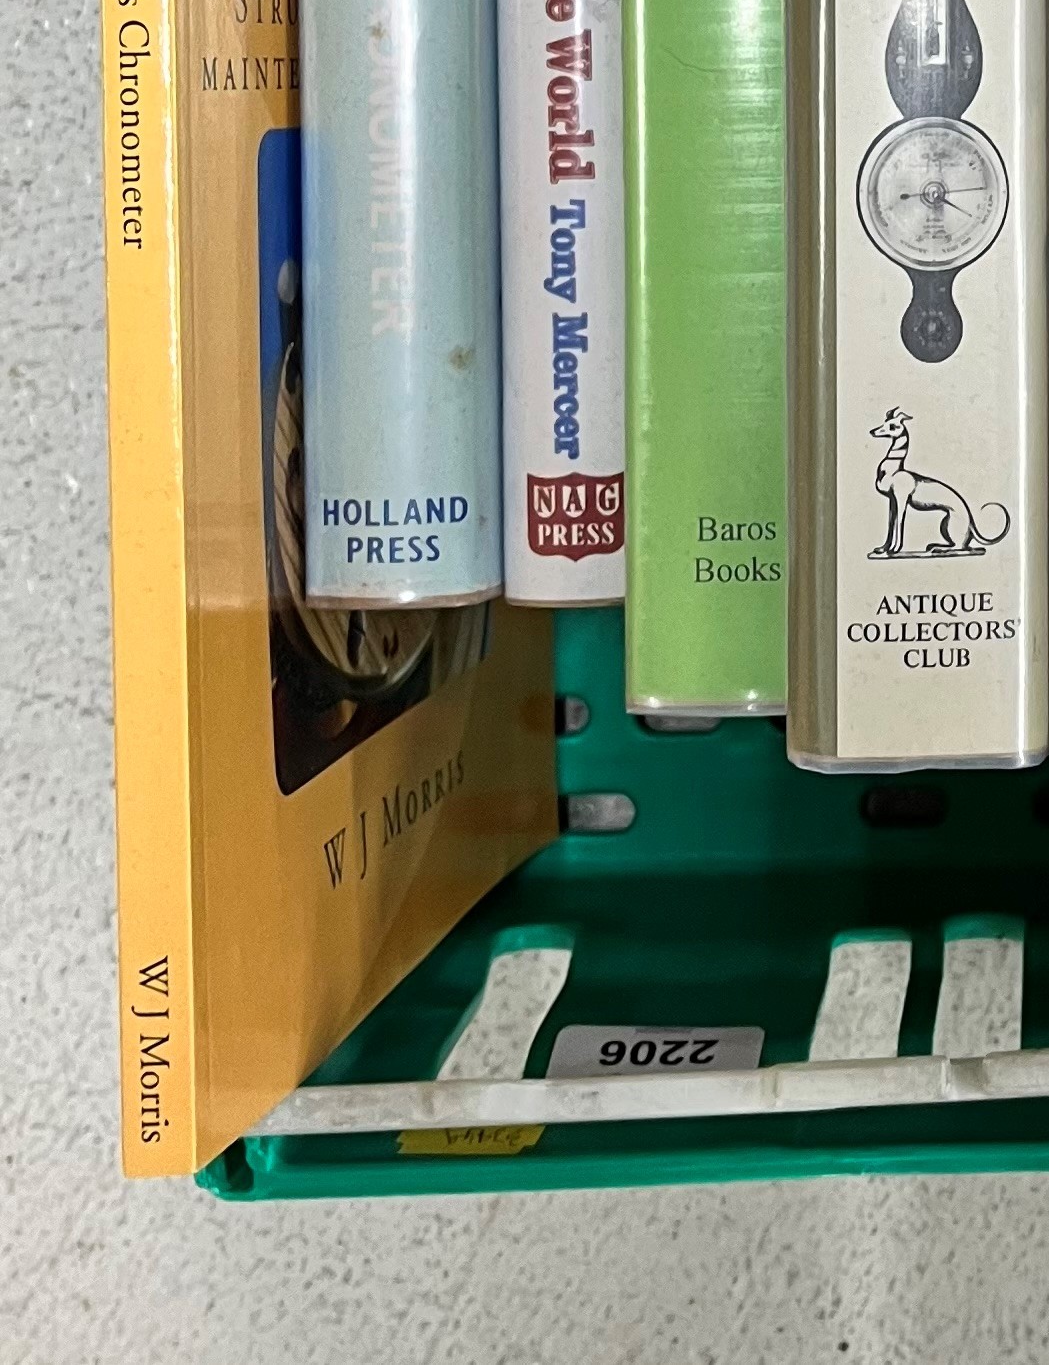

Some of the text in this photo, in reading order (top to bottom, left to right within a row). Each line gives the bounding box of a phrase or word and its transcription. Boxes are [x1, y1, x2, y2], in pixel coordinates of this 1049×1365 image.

[545, 28, 597, 185] World
[117, 20, 151, 251] Chronometer
[543, 198, 589, 461] Tony Mercer
[322, 496, 469, 527] HOLLAND
[537, 521, 616, 547] PRESS
[697, 516, 777, 542] Baros
[346, 534, 441, 564] PRESS
[694, 556, 782, 584] Books
[876, 592, 994, 617] ANTIQUE
[903, 647, 971, 668] CLUB
[323, 826, 347, 891] W
[131, 954, 171, 1144] W J Morris
[599, 1039, 720, 1067] 2206
